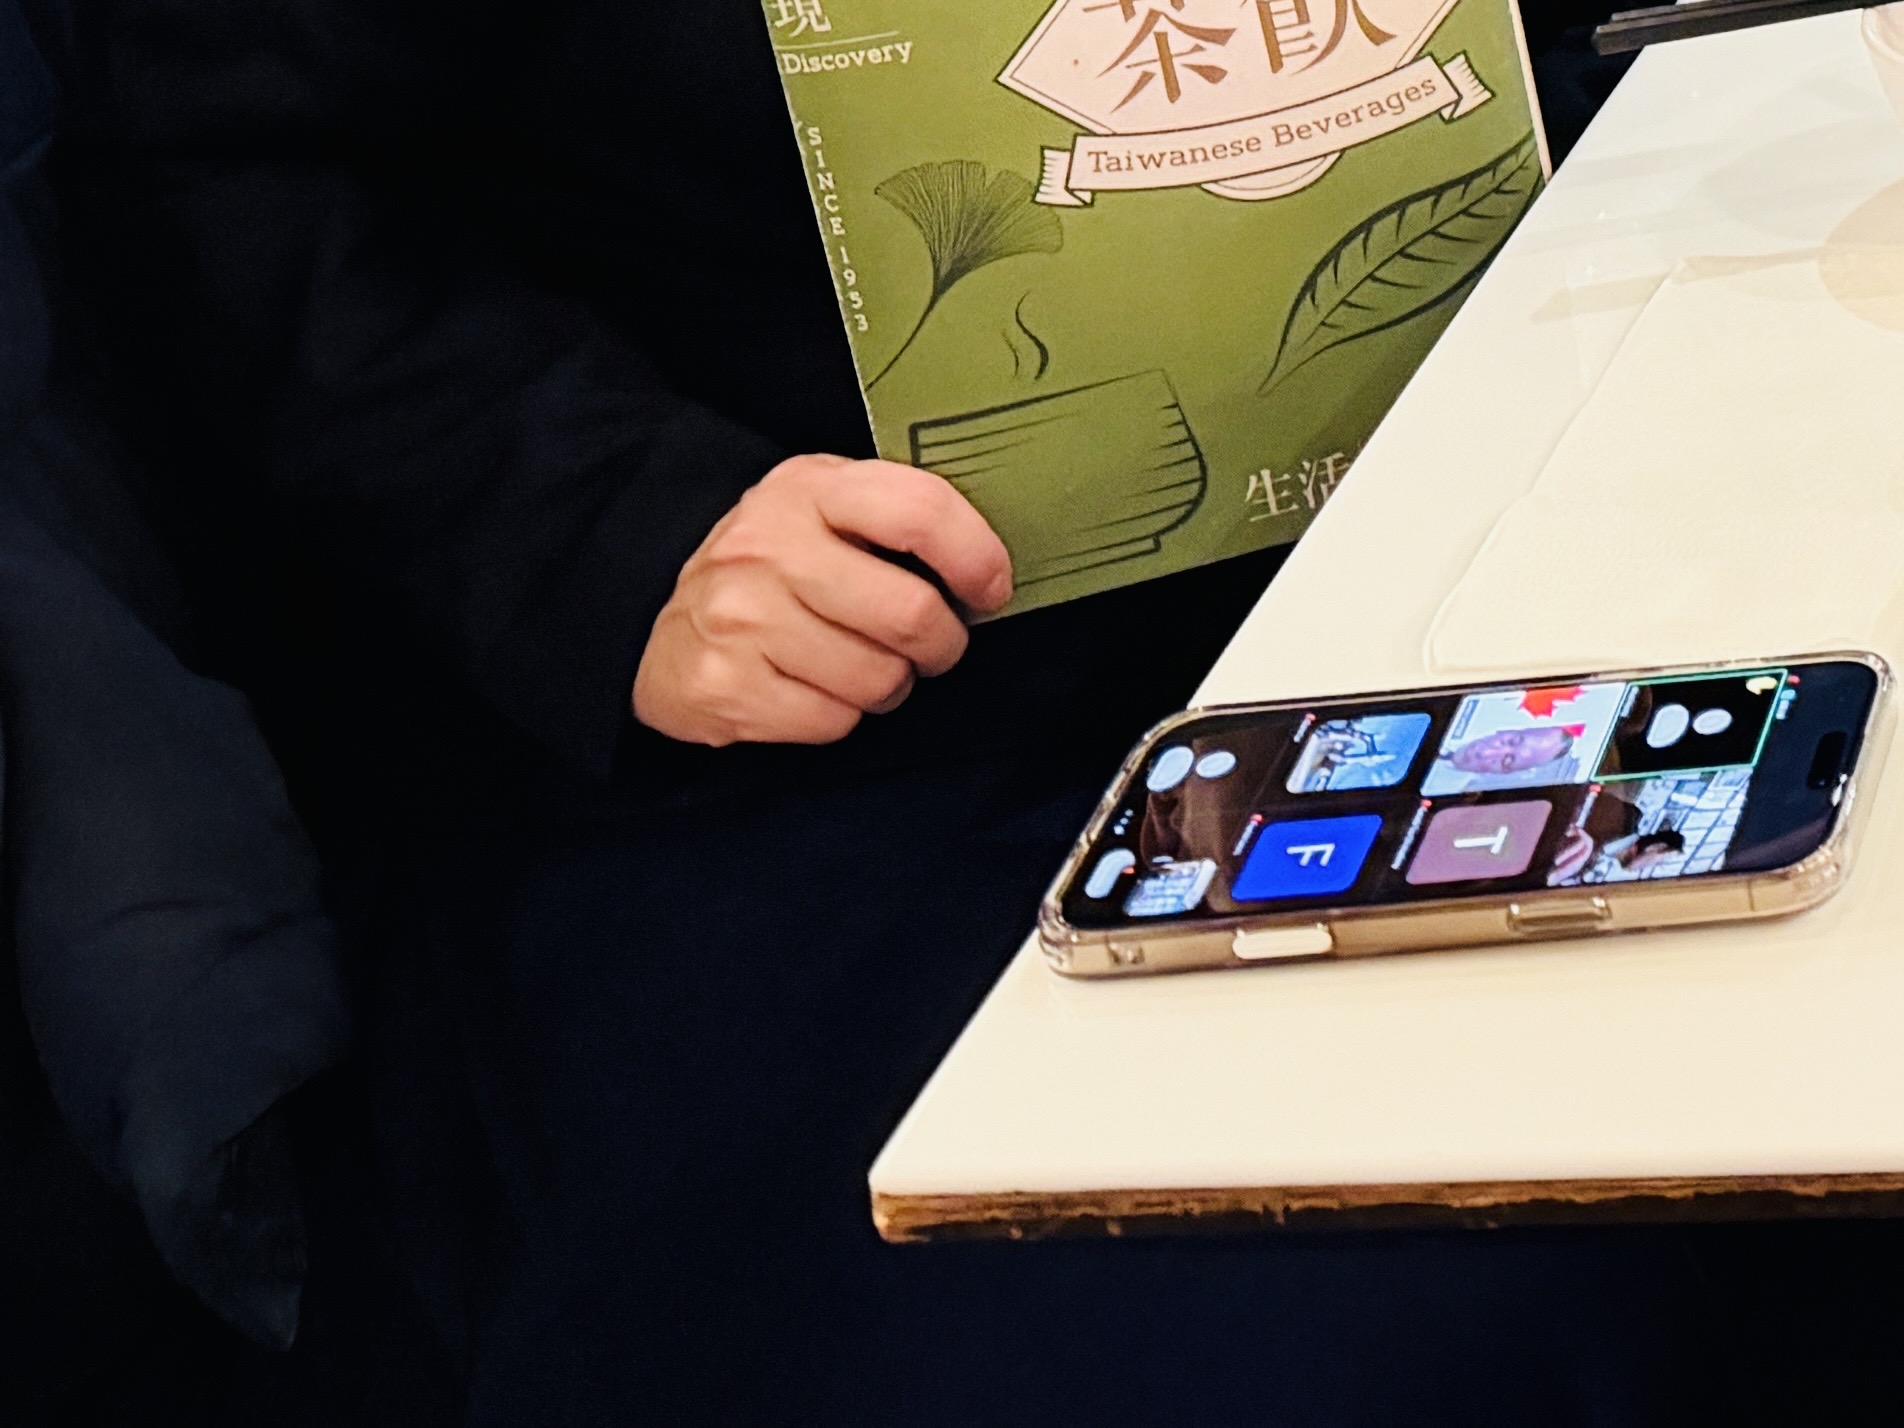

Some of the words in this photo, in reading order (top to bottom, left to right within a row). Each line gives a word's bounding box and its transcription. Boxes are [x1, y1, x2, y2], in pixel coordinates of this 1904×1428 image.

[783, 39, 913, 75] Discovery
[1087, 137, 1262, 174] Taiwanese
[1271, 75, 1436, 148] Beverages
[807, 126, 846, 236] SINCE
[839, 245, 869, 332] 1953
